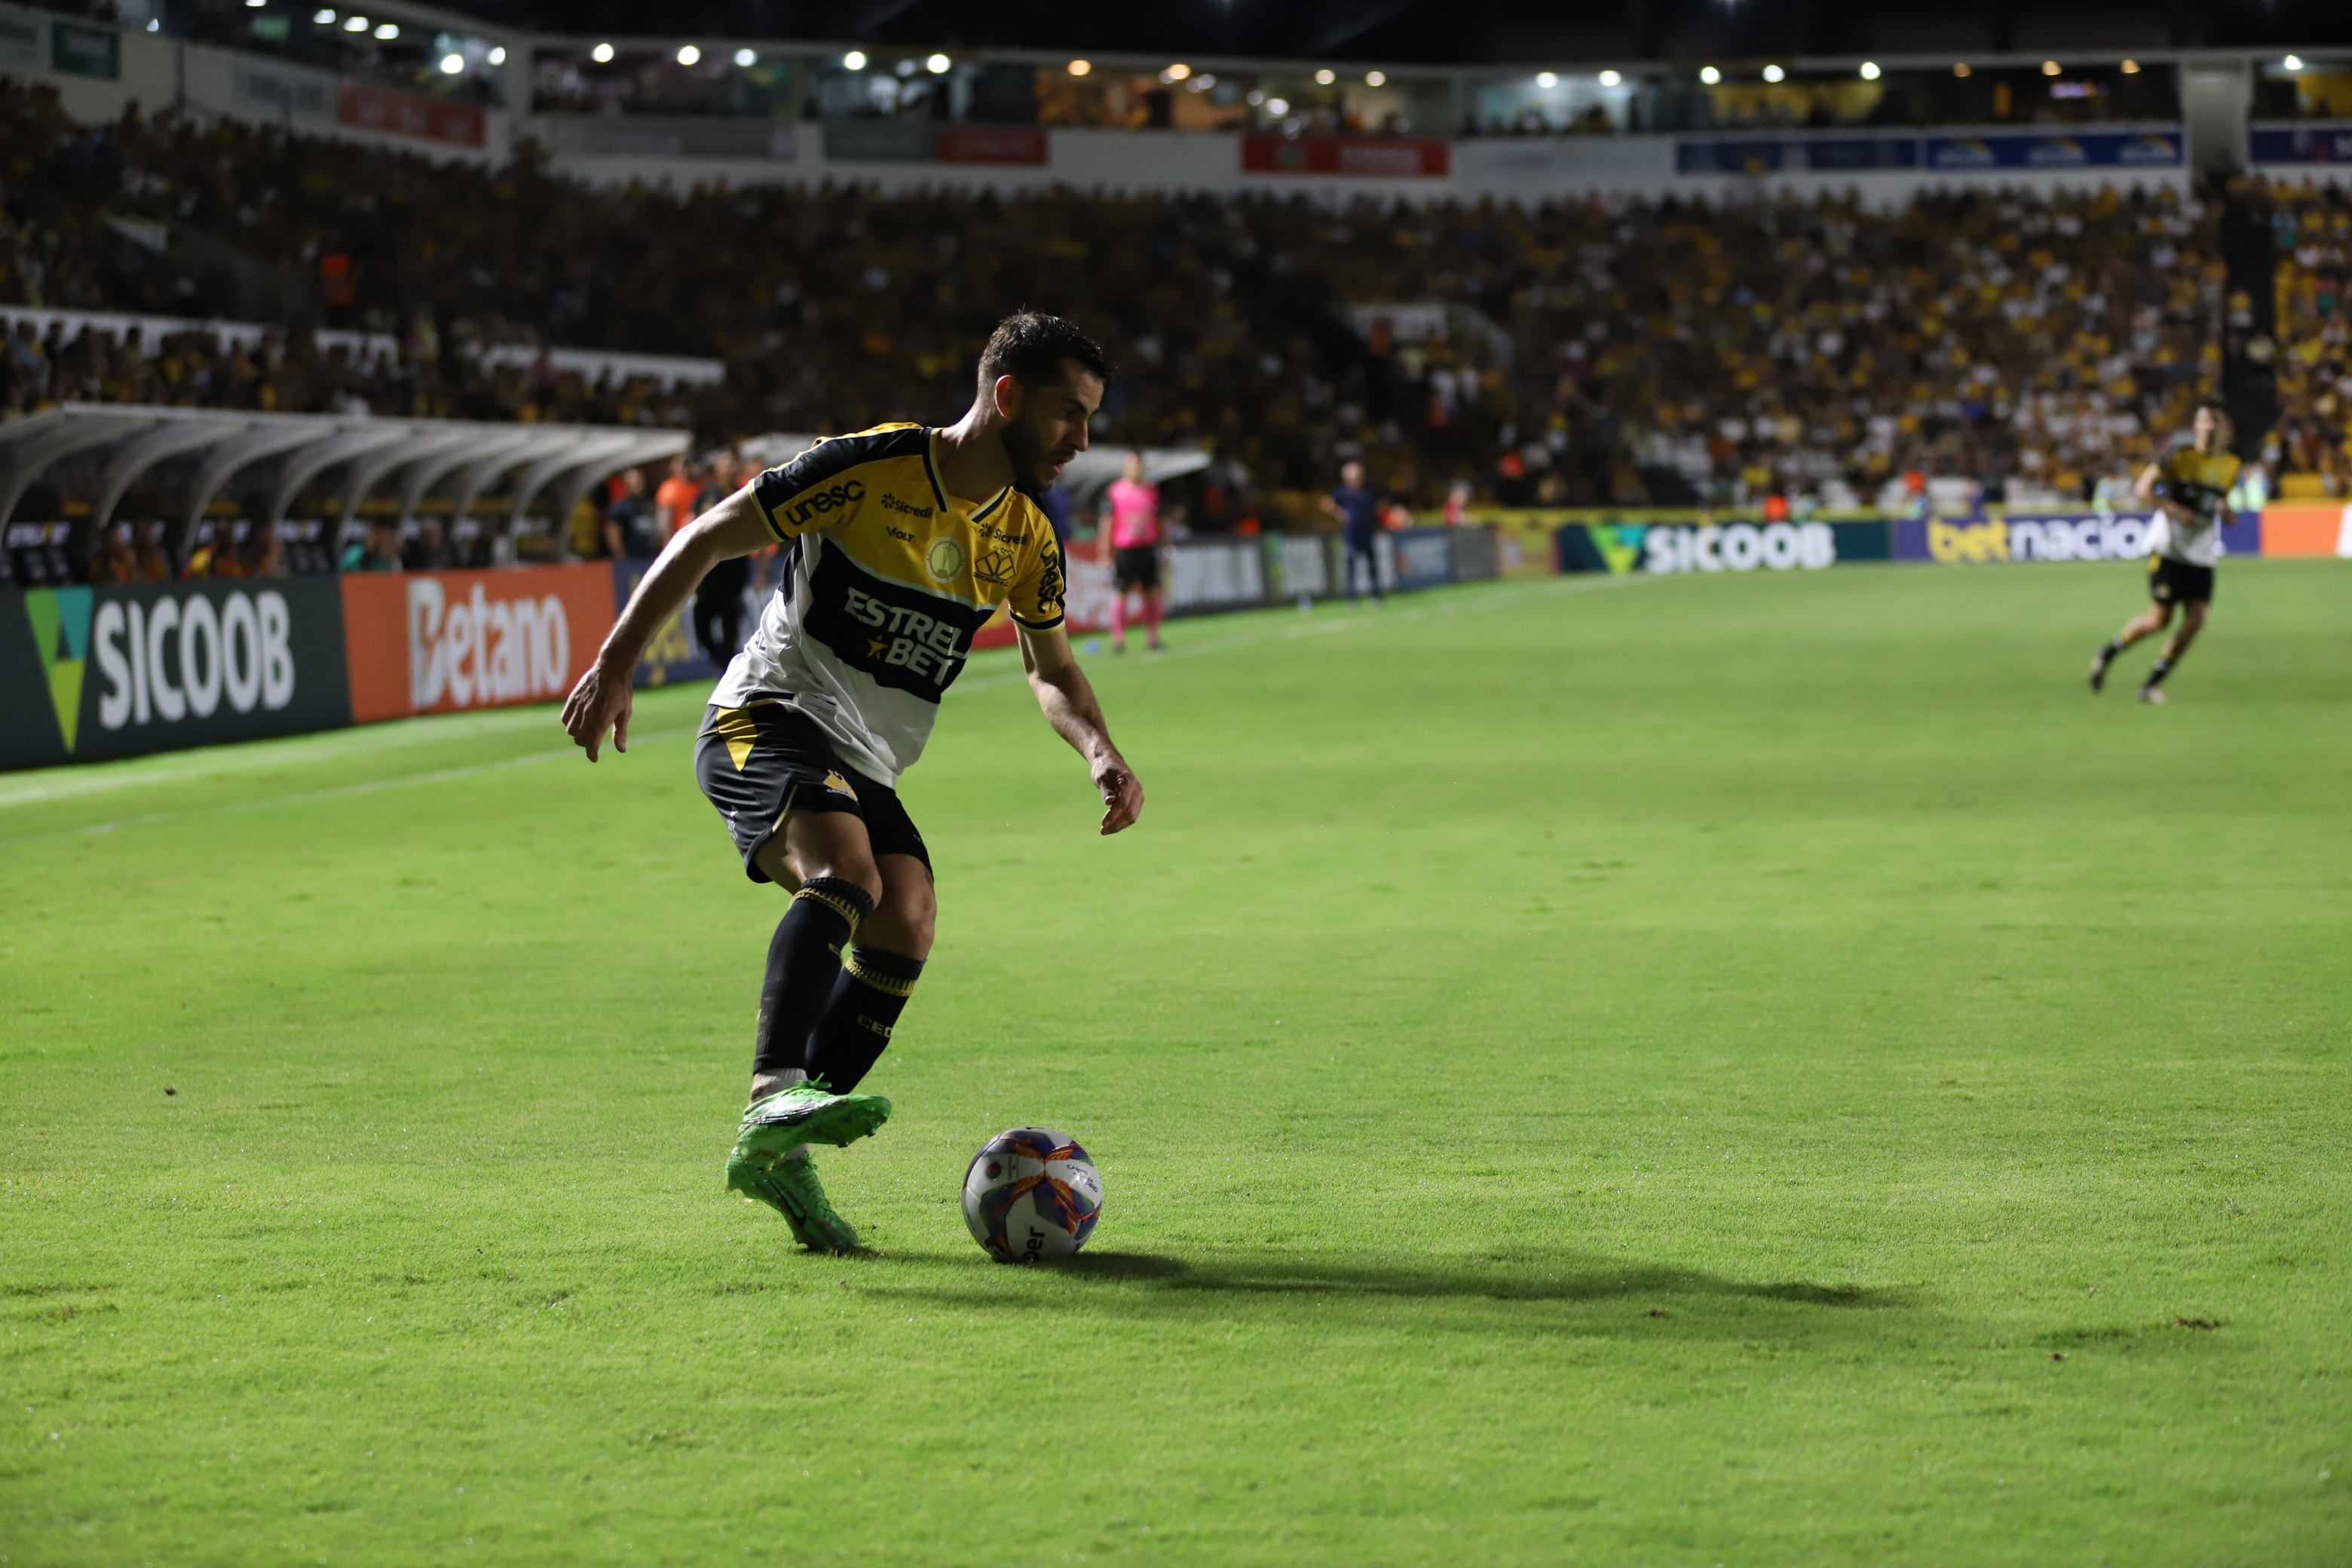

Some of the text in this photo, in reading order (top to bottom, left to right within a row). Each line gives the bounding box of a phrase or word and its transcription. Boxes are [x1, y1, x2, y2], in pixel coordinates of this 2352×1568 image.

[786, 480, 865, 525] unesc
[895, 498, 933, 518] Sicredi
[886, 525, 915, 542] VOLT
[1643, 522, 1836, 574] SICOOB
[408, 577, 570, 710] Betano
[844, 586, 968, 660] ESTREL
[94, 590, 296, 730] SICOOB
[884, 637, 956, 687] BET
